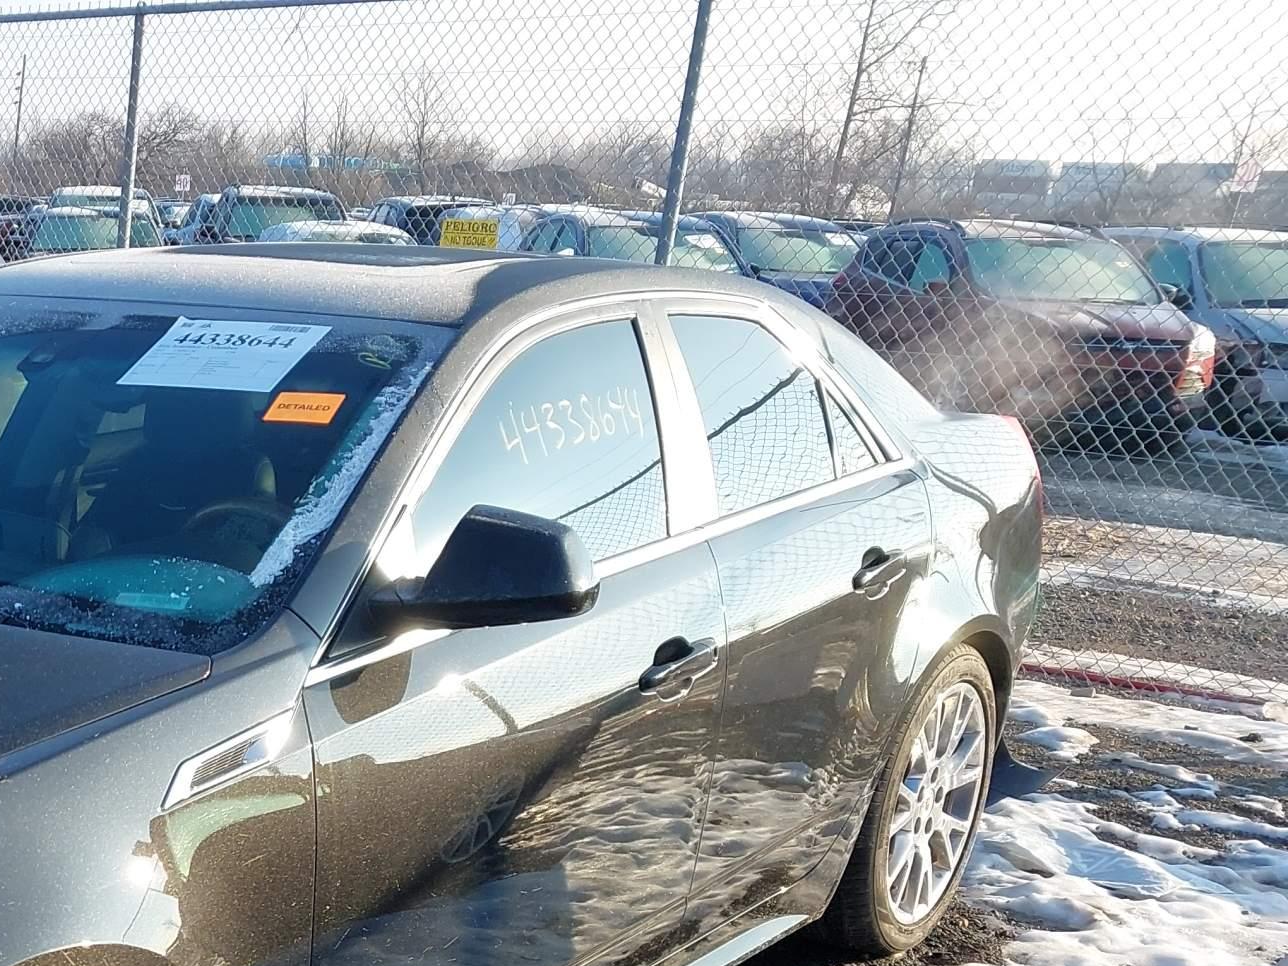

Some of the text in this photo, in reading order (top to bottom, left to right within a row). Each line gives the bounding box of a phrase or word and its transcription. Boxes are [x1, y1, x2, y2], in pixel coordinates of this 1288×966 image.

[445, 220, 498, 233] PELIGRO
[450, 235, 487, 247] NO TOQUE
[173, 332, 297, 350] 44338644
[276, 402, 332, 413] DETAILED
[497, 386, 645, 465] 44338644
